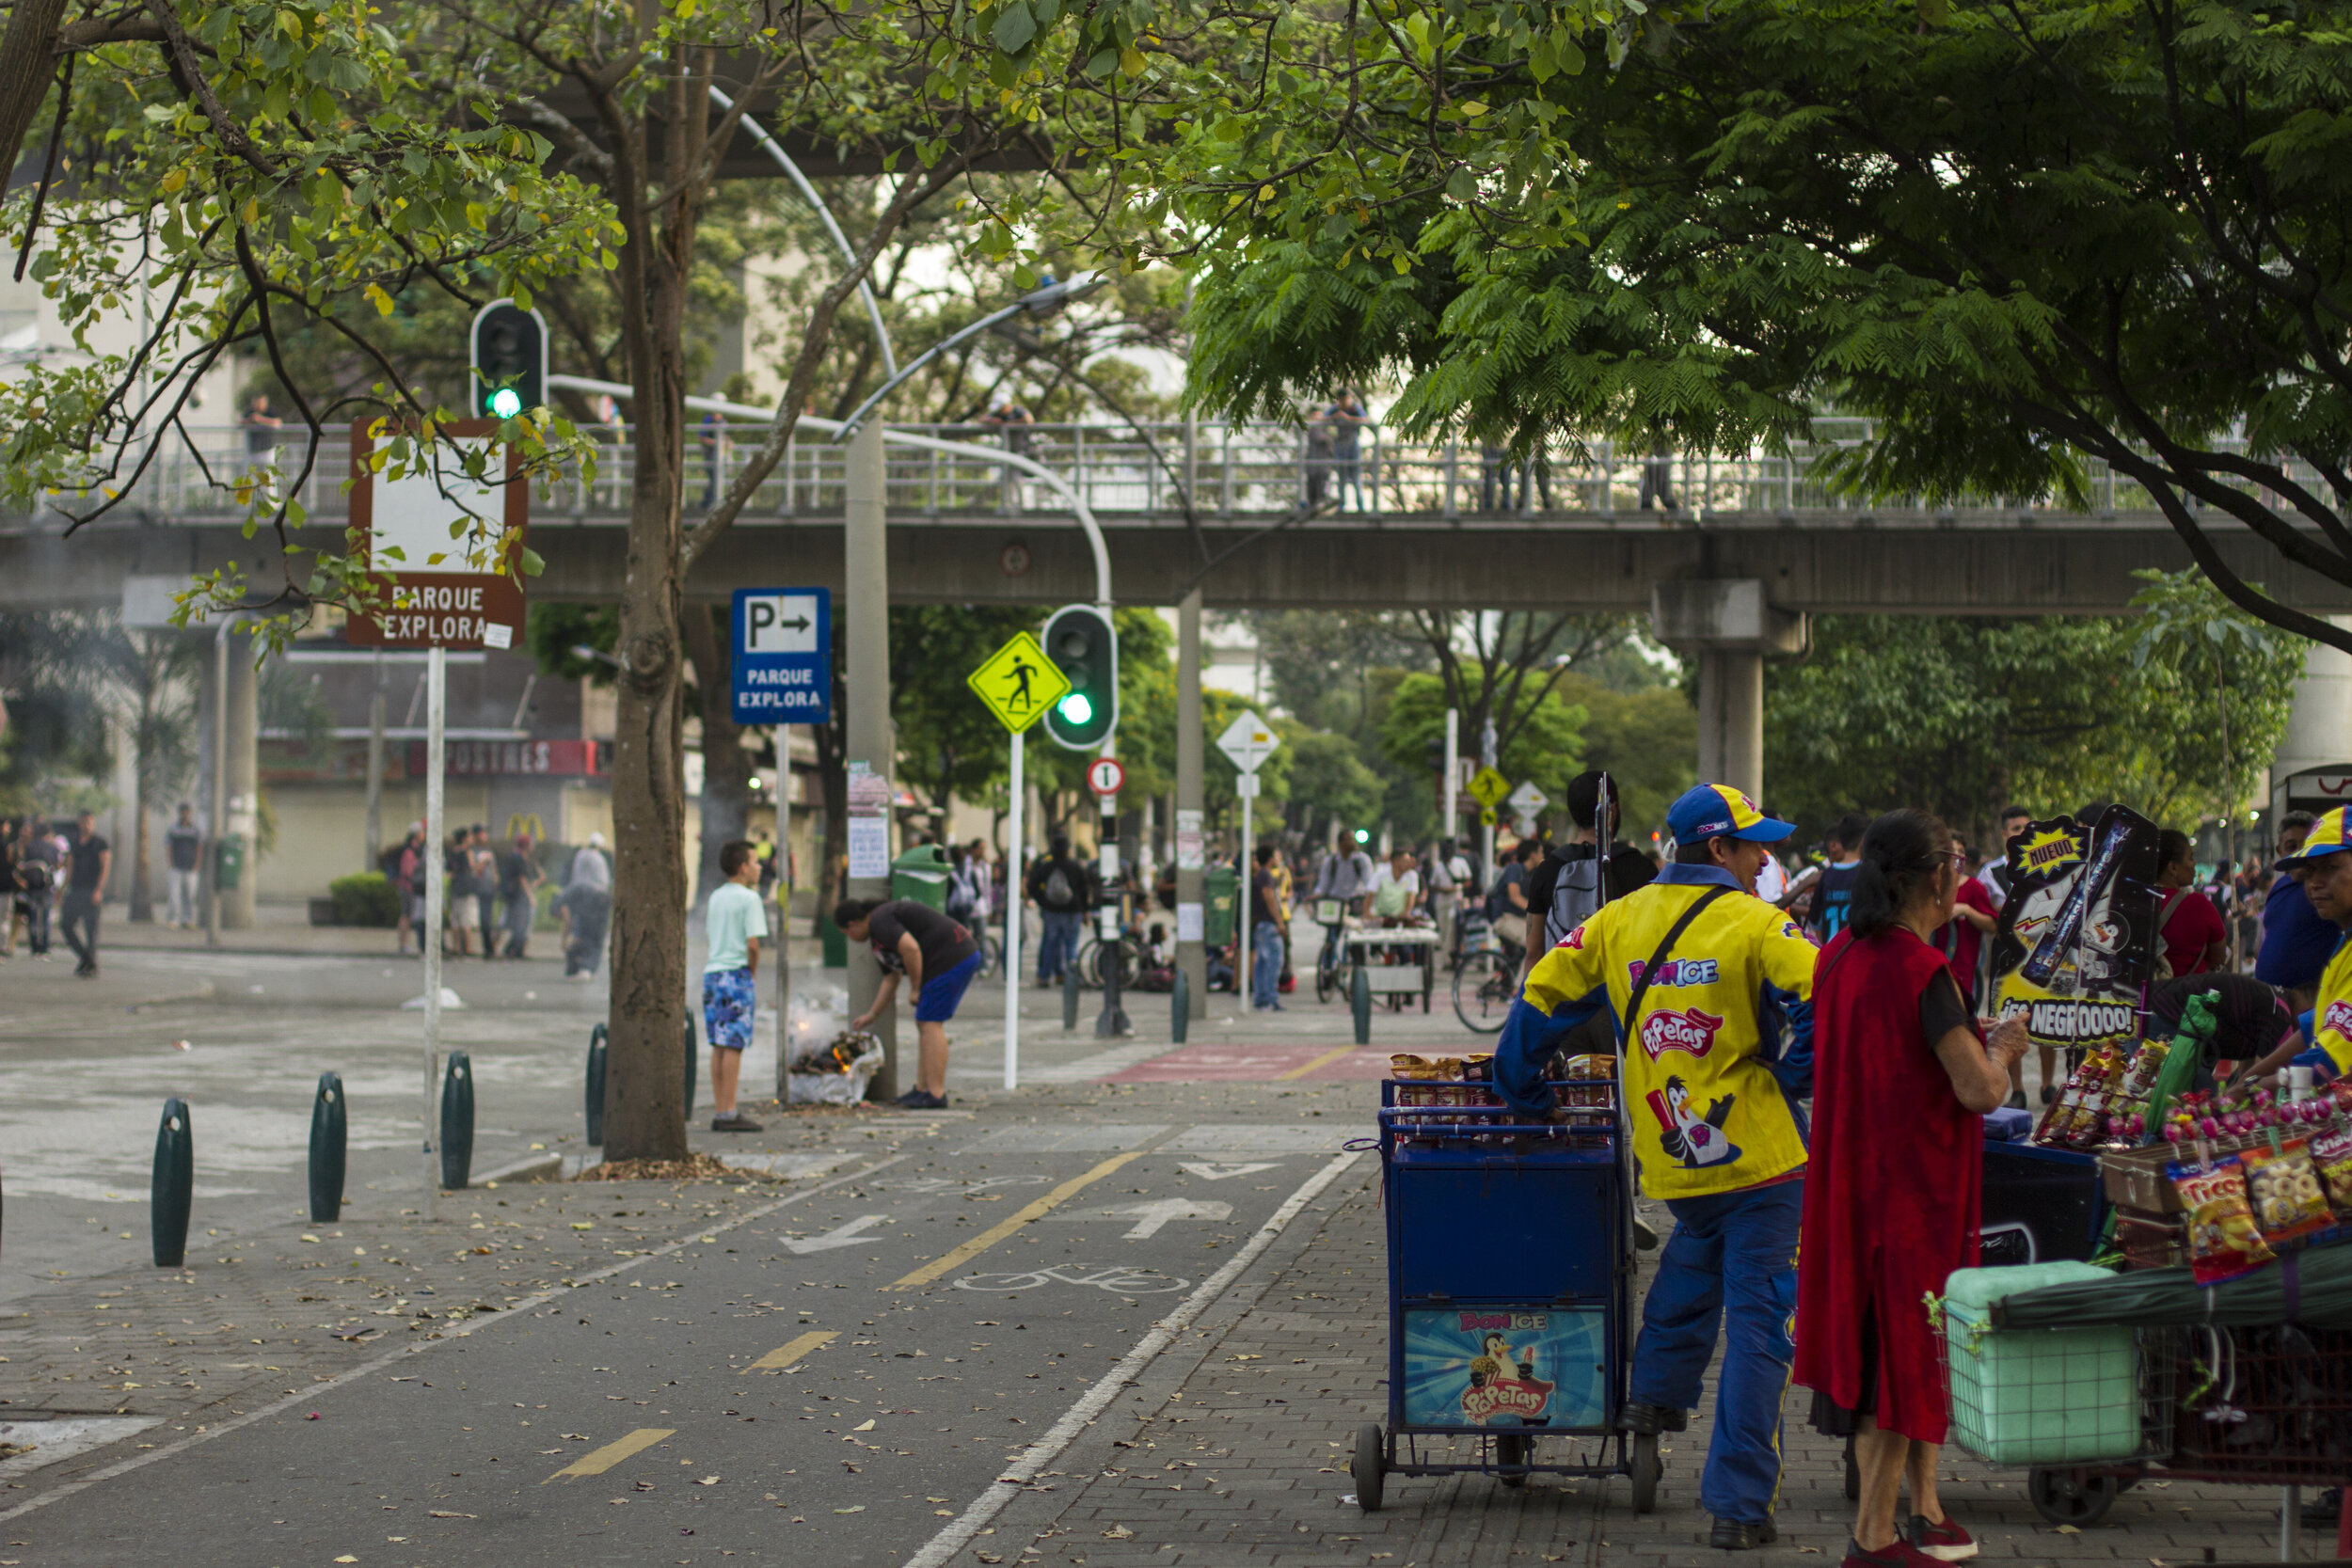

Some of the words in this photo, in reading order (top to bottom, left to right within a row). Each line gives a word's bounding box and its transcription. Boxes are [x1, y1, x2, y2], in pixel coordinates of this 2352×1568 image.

[391, 586, 484, 611] PARQUE
[383, 615, 485, 641] EXPLORA
[749, 601, 776, 648] P
[747, 669, 813, 685] PARQUE
[738, 690, 821, 707] EXPLORA
[2029, 839, 2074, 867] NUEVO
[2029, 1001, 2133, 1037] NEGROOOO!
